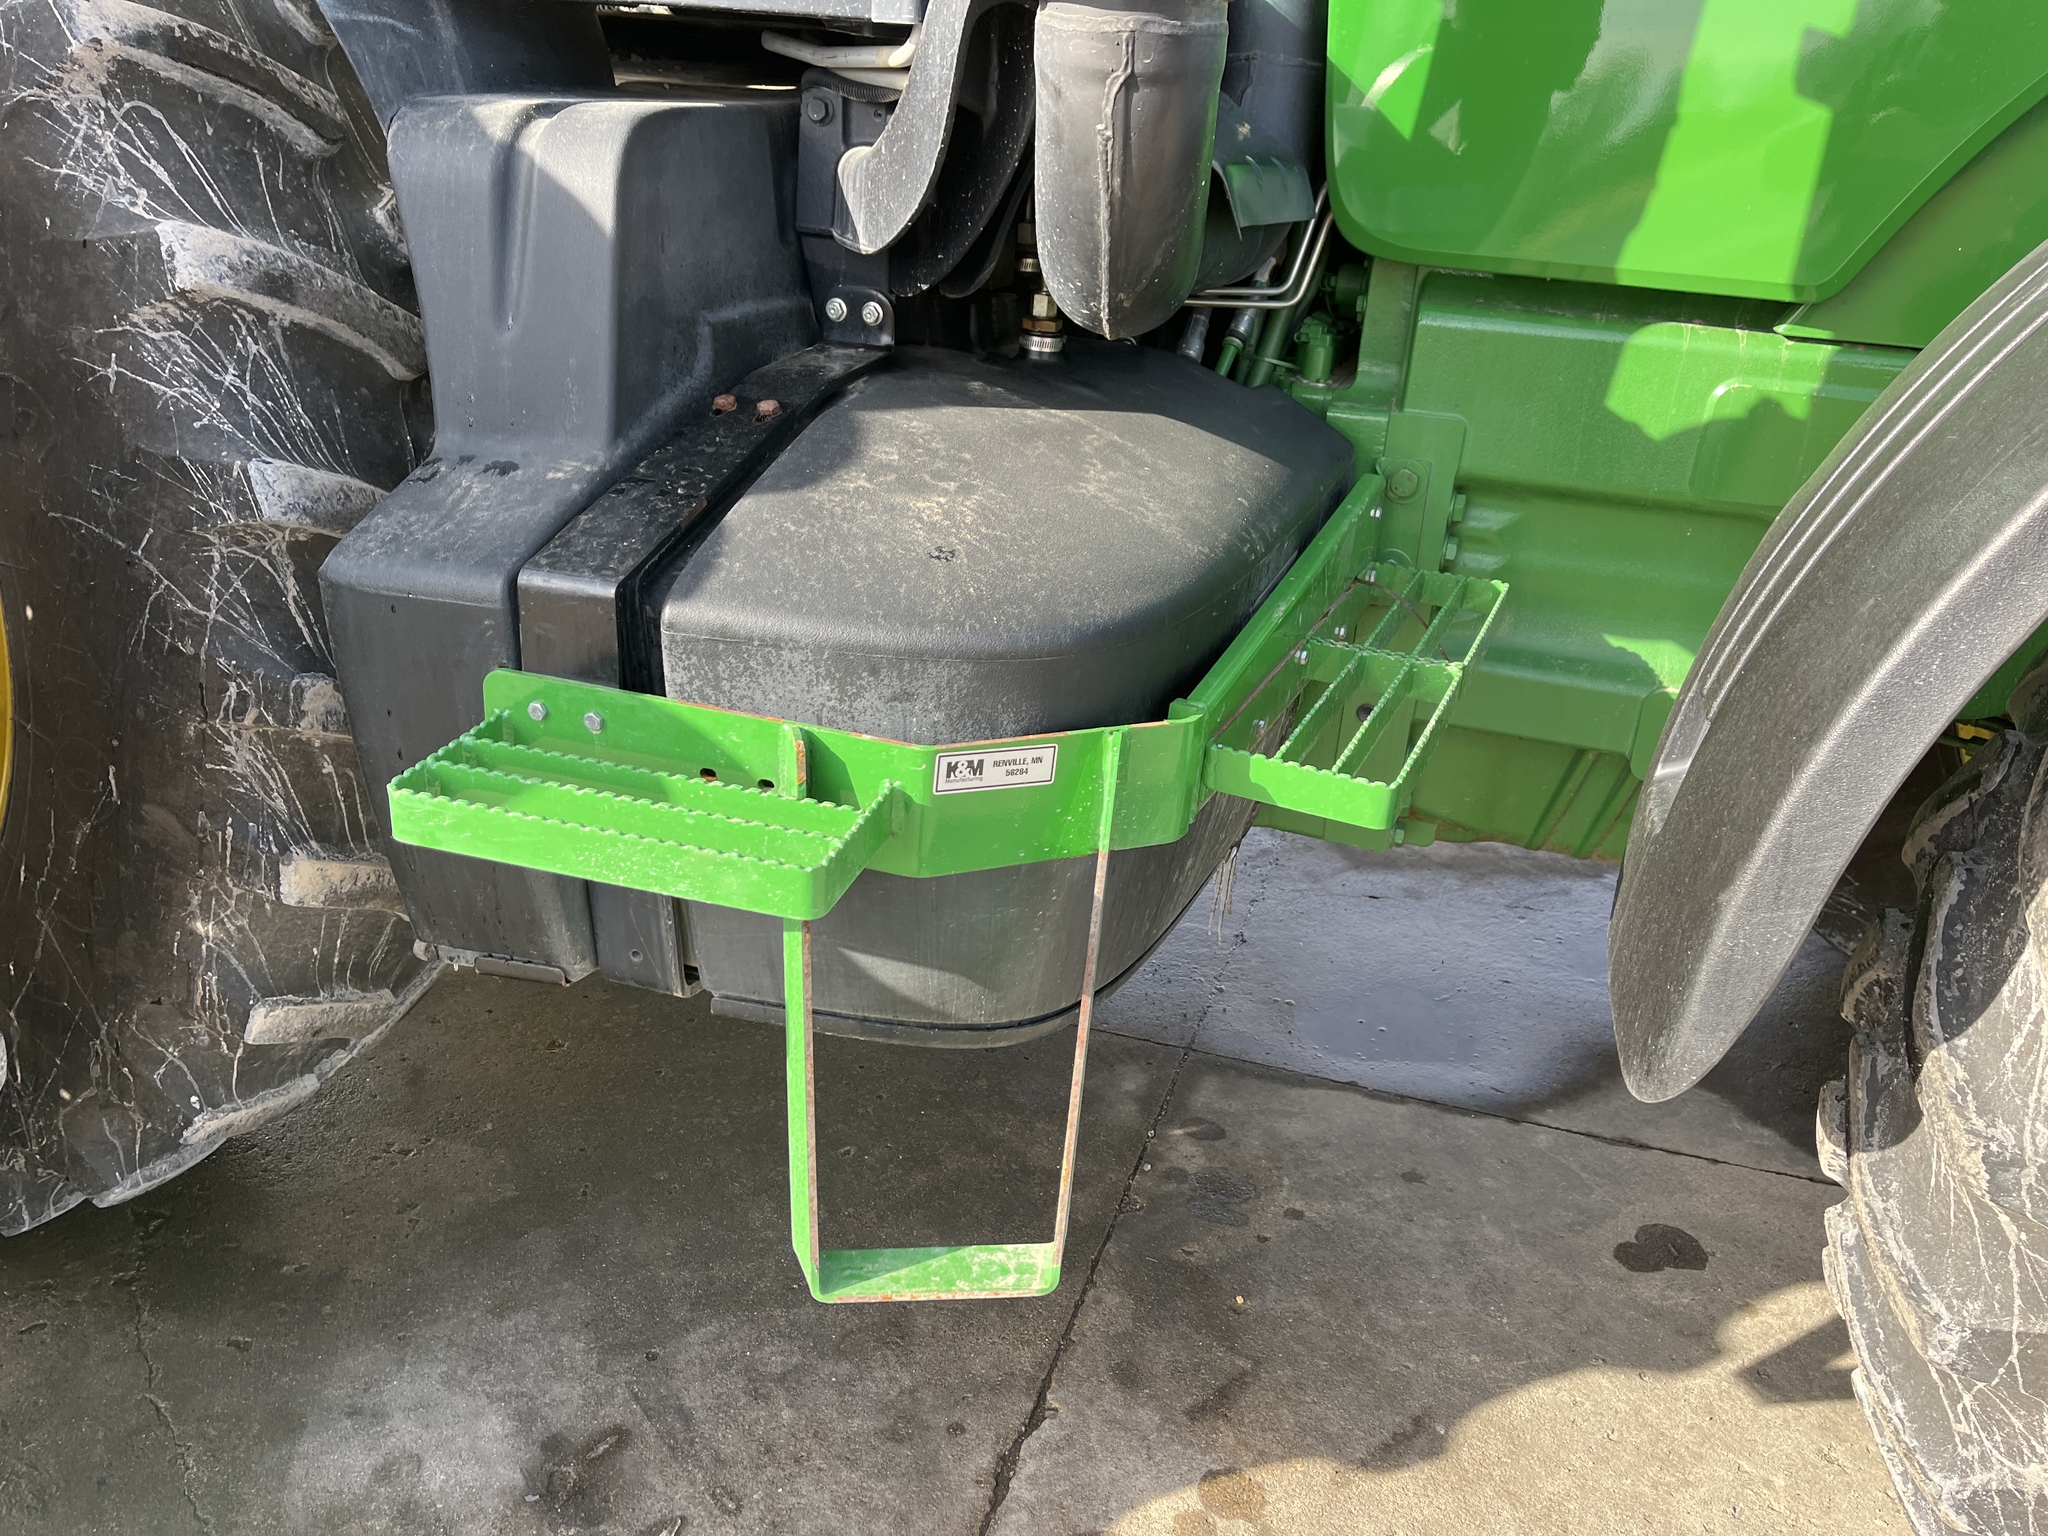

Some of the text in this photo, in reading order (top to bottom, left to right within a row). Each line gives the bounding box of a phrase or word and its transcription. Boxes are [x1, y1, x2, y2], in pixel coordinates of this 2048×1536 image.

[993, 756, 1043, 768] RENVILLE, MN
[946, 759, 984, 778] K&M
[1005, 767, 1028, 777] 56284
[945, 776, 983, 784] Manufacturing
